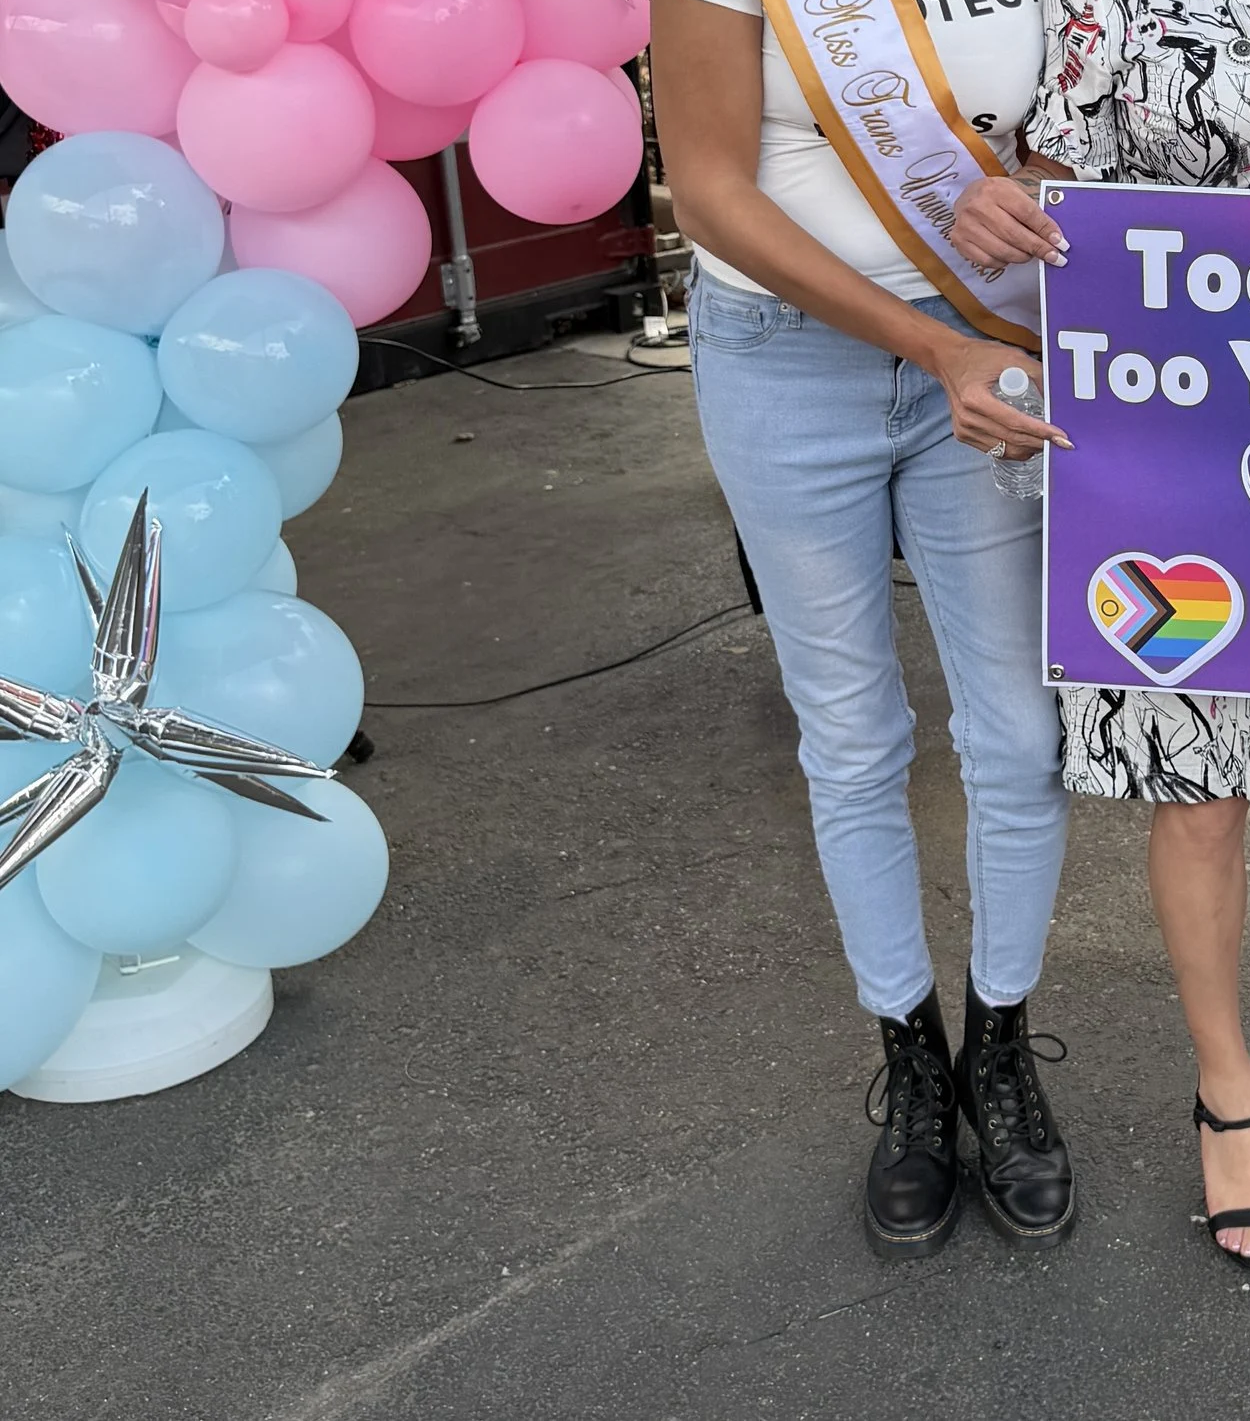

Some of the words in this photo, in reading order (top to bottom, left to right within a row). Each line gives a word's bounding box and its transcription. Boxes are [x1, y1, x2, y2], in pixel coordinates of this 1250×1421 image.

[841, 70, 917, 158] Trans
[899, 150, 960, 248] Univer
[1057, 330, 1210, 407] Too
